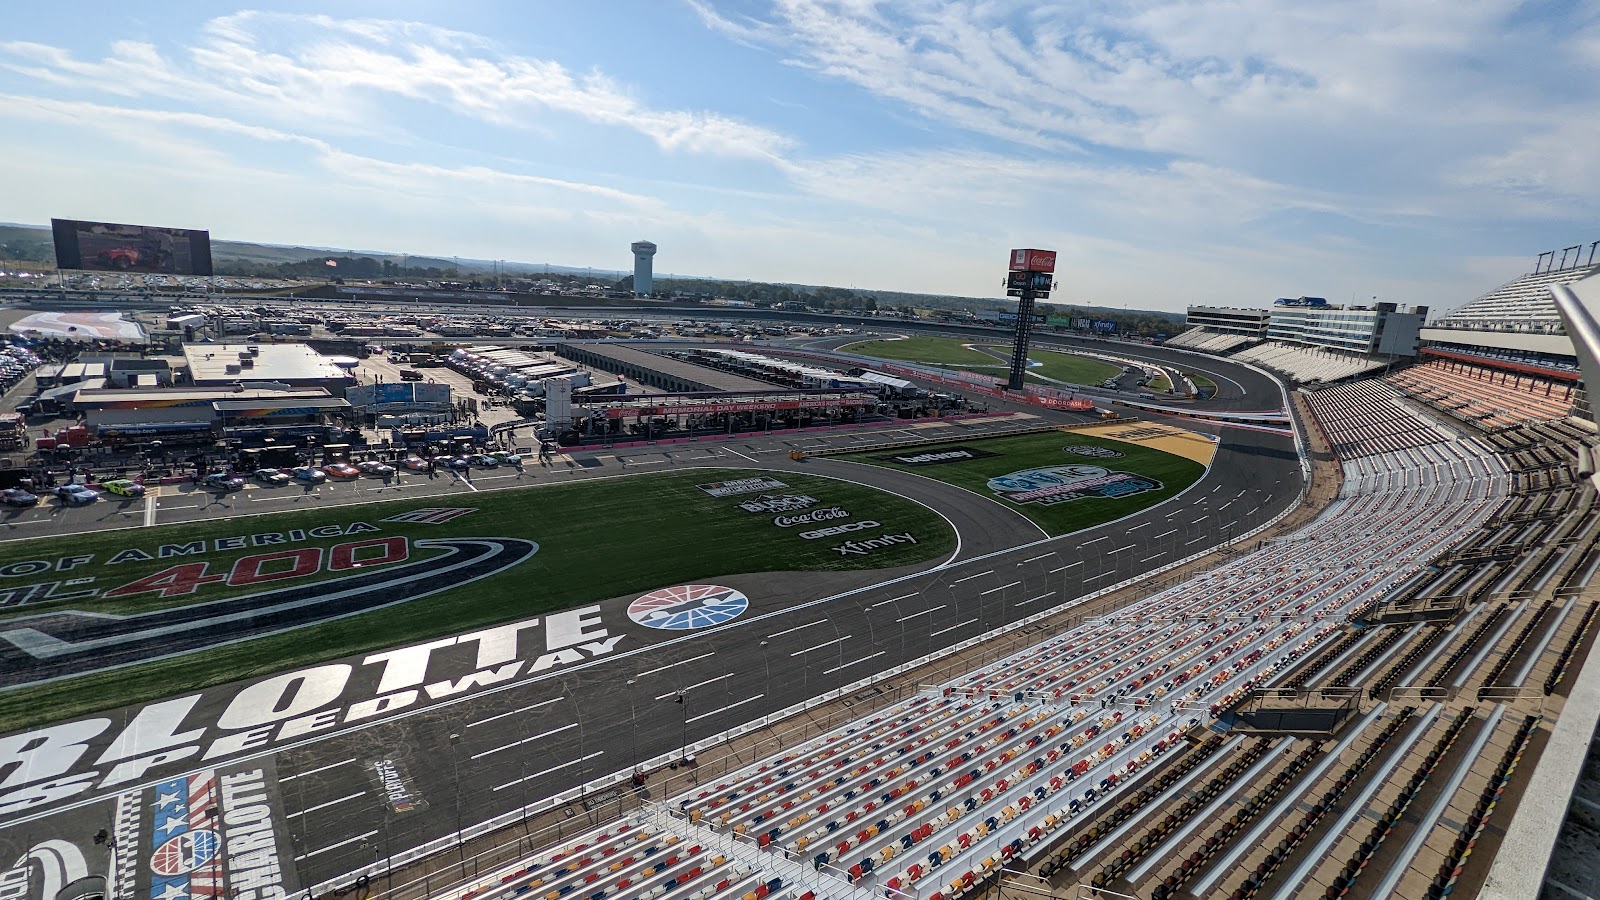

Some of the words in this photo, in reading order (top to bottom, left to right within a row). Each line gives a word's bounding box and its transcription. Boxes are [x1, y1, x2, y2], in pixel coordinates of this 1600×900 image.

[1031, 256, 1054, 267] Coca-Cola
[1093, 321, 1114, 332] xfinity
[663, 405, 714, 414] MEMORIAL
[1048, 399, 1082, 407] DOORDASH
[896, 450, 973, 464] betway
[739, 494, 820, 513] BUSCH
[774, 506, 850, 528] Coca-Cola
[799, 520, 881, 540] GEICO
[0, 553, 96, 577] OF
[104, 521, 381, 566] AMERICA
[832, 531, 917, 555] xfinity
[101, 535, 410, 599] 400
[0, 634, 626, 815] SPEEDWAY
